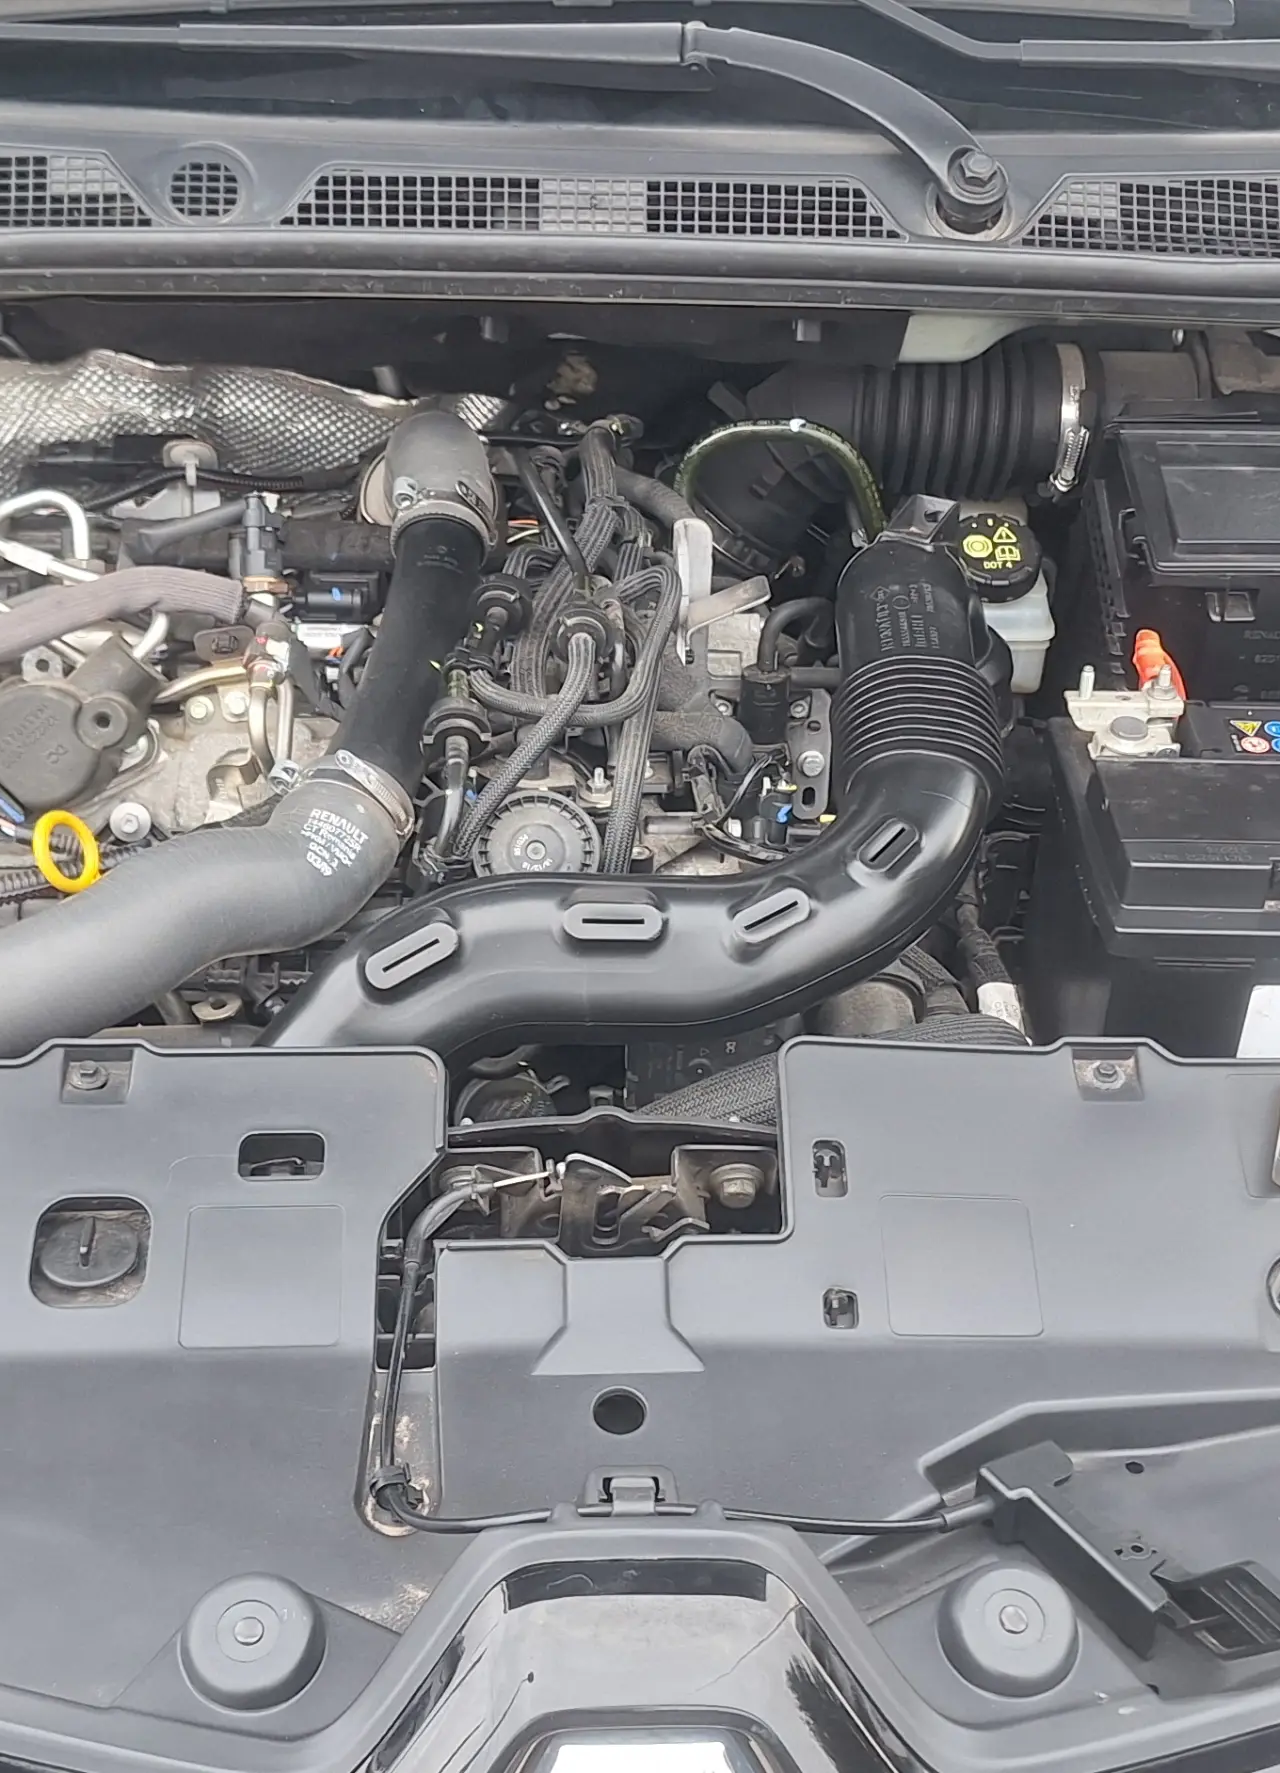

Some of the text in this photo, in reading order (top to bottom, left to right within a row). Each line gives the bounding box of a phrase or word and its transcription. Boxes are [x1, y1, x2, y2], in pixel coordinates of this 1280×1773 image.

[983, 561, 1013, 570] DOT 4
[303, 823, 318, 833] CT
[309, 808, 369, 845] RENAULT
